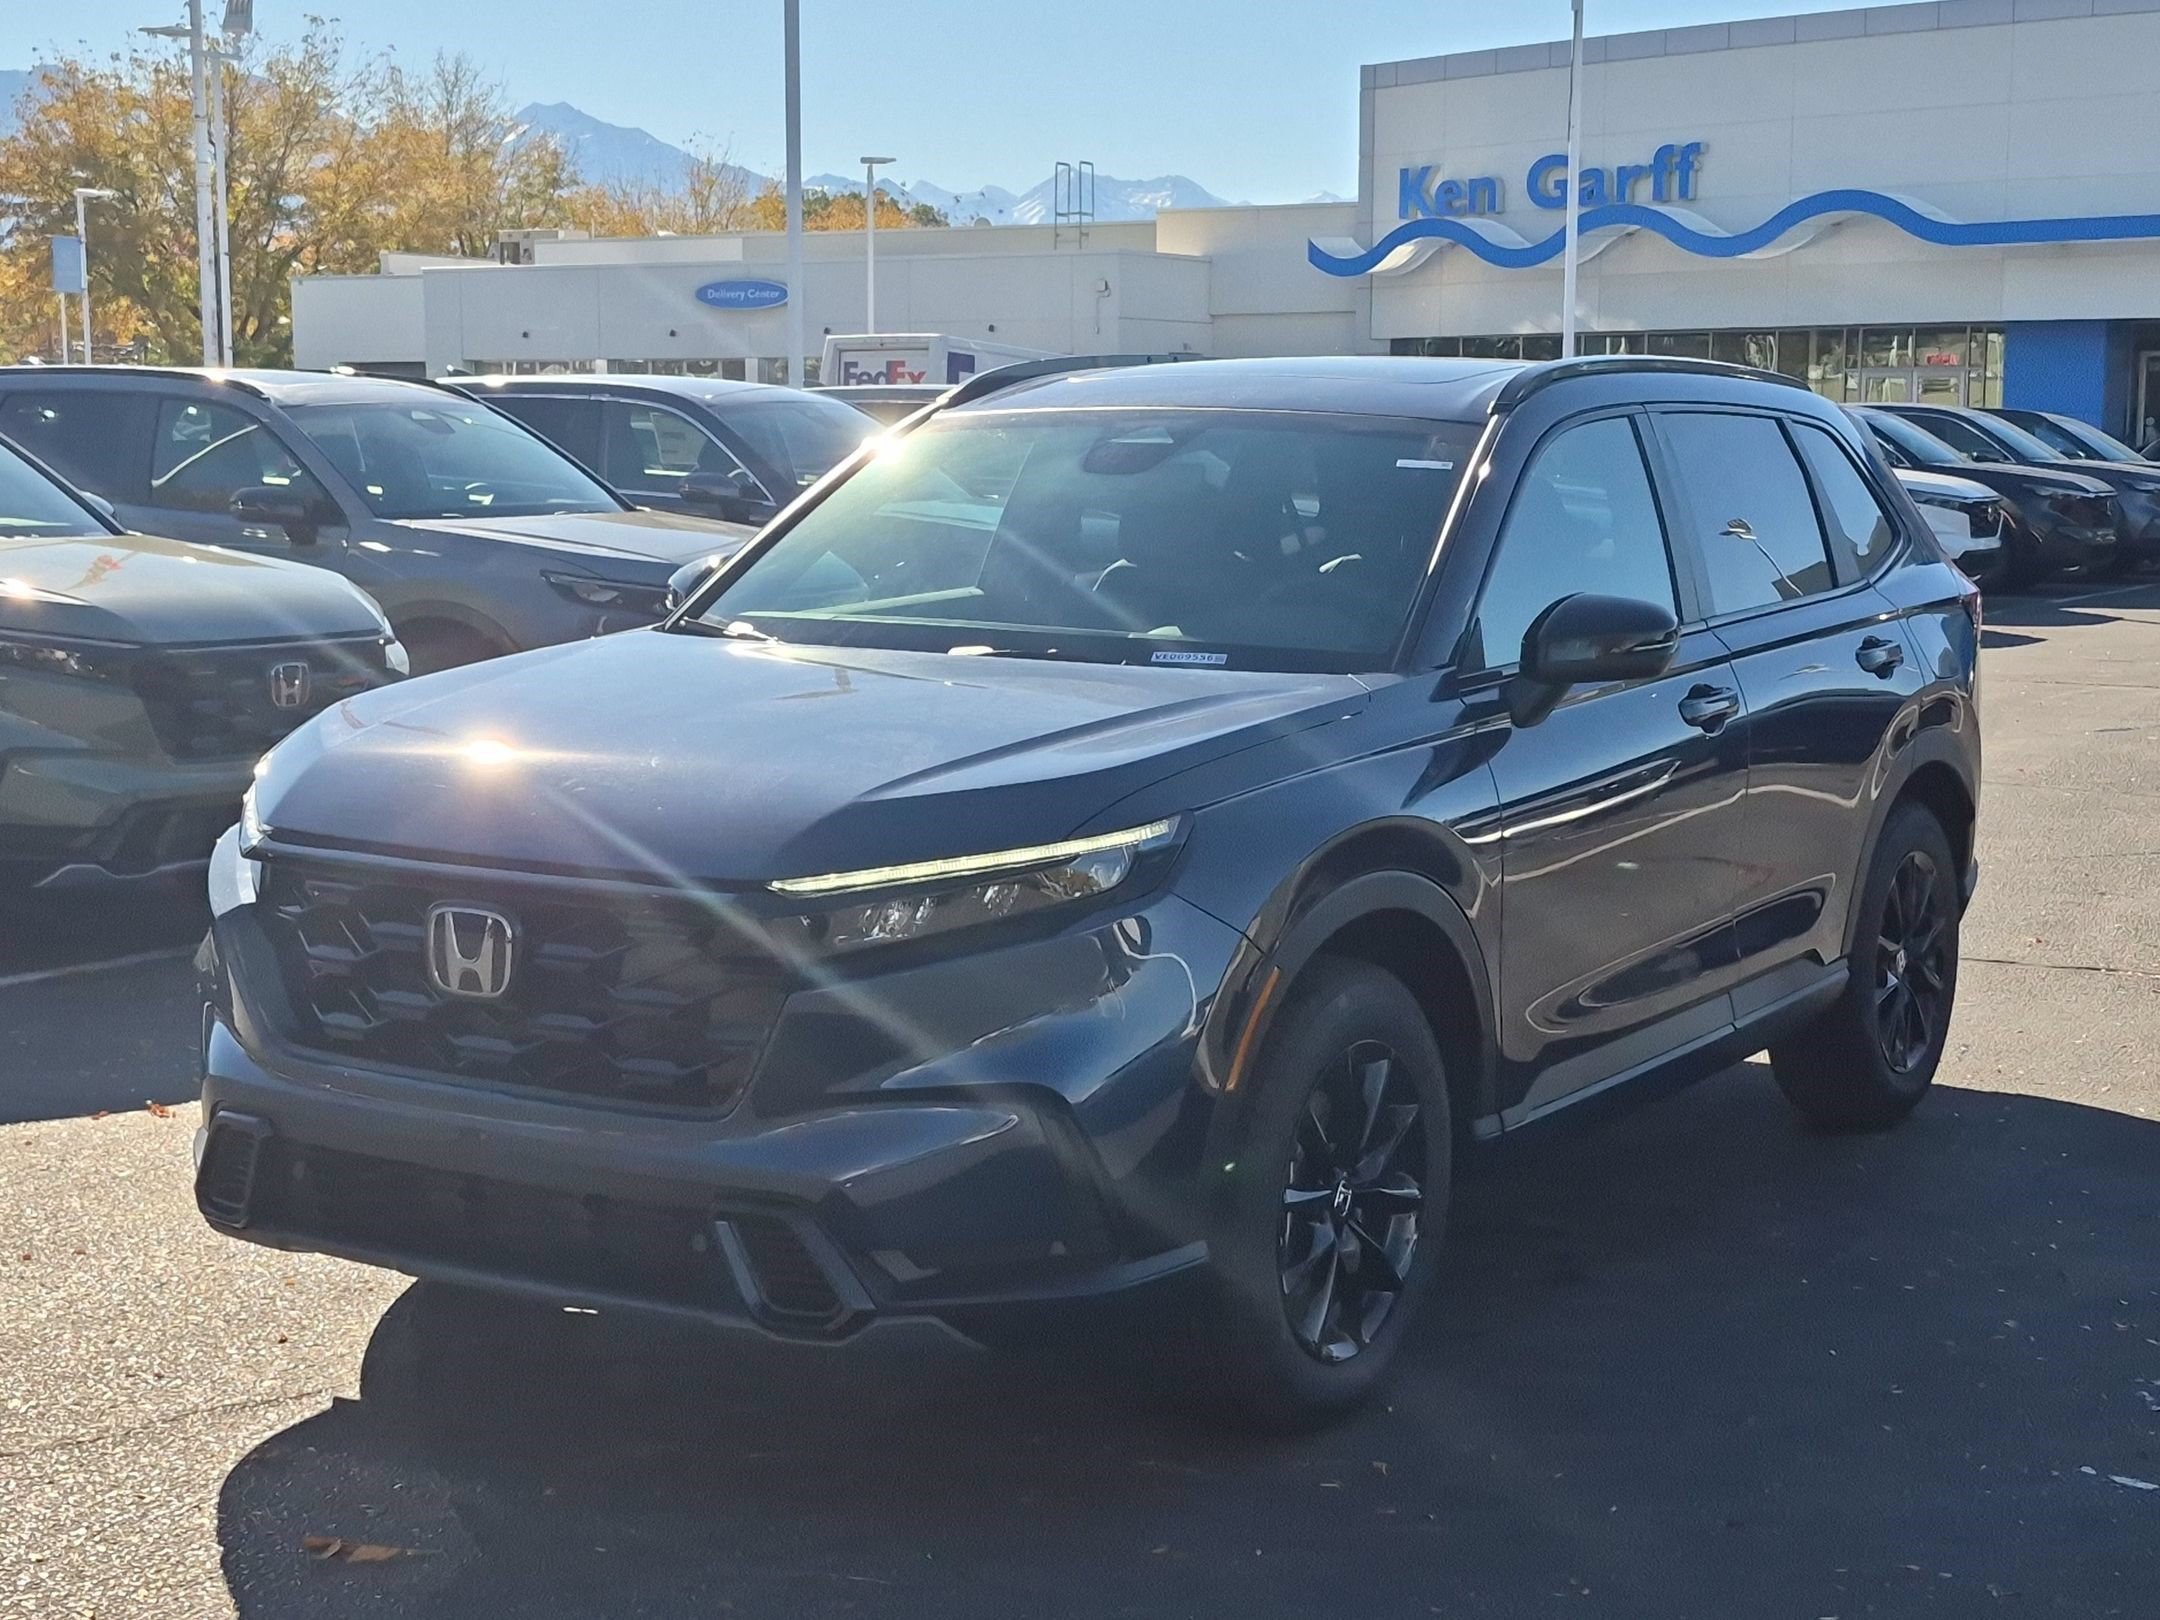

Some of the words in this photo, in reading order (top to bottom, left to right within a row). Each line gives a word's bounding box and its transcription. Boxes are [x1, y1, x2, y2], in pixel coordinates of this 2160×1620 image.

[1398, 165, 1501, 219] Ken
[1526, 142, 1706, 209] Garff
[707, 288, 745, 302] Delivery
[747, 288, 779, 299] Center
